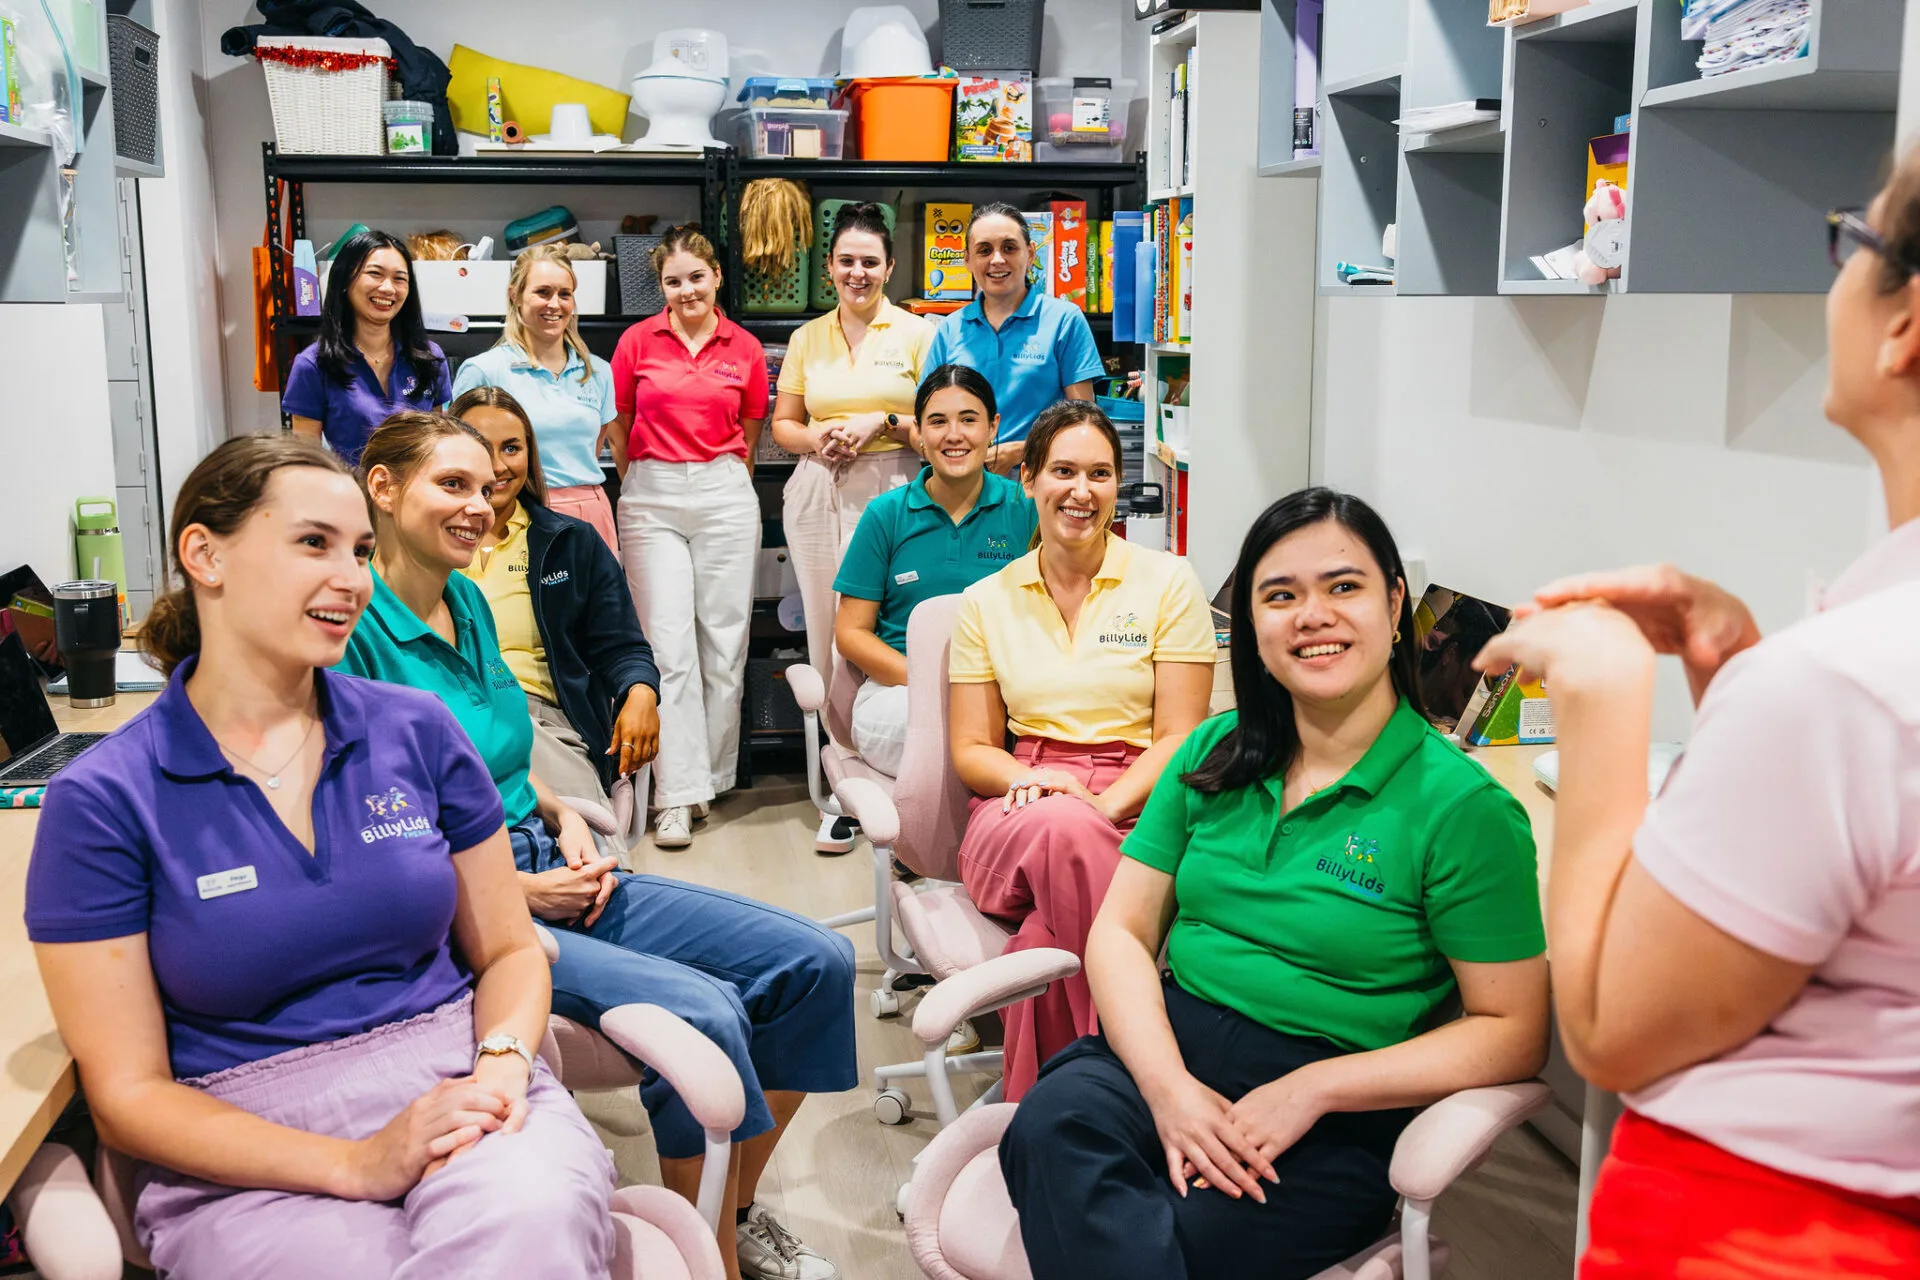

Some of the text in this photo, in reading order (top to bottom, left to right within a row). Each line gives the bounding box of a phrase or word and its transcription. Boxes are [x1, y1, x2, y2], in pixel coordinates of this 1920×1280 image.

[1012, 353, 1045, 361] BillyLids
[1099, 633, 1148, 644] BillyLids
[361, 815, 431, 843] BillyLids
[1316, 858, 1385, 894] BillyLids
